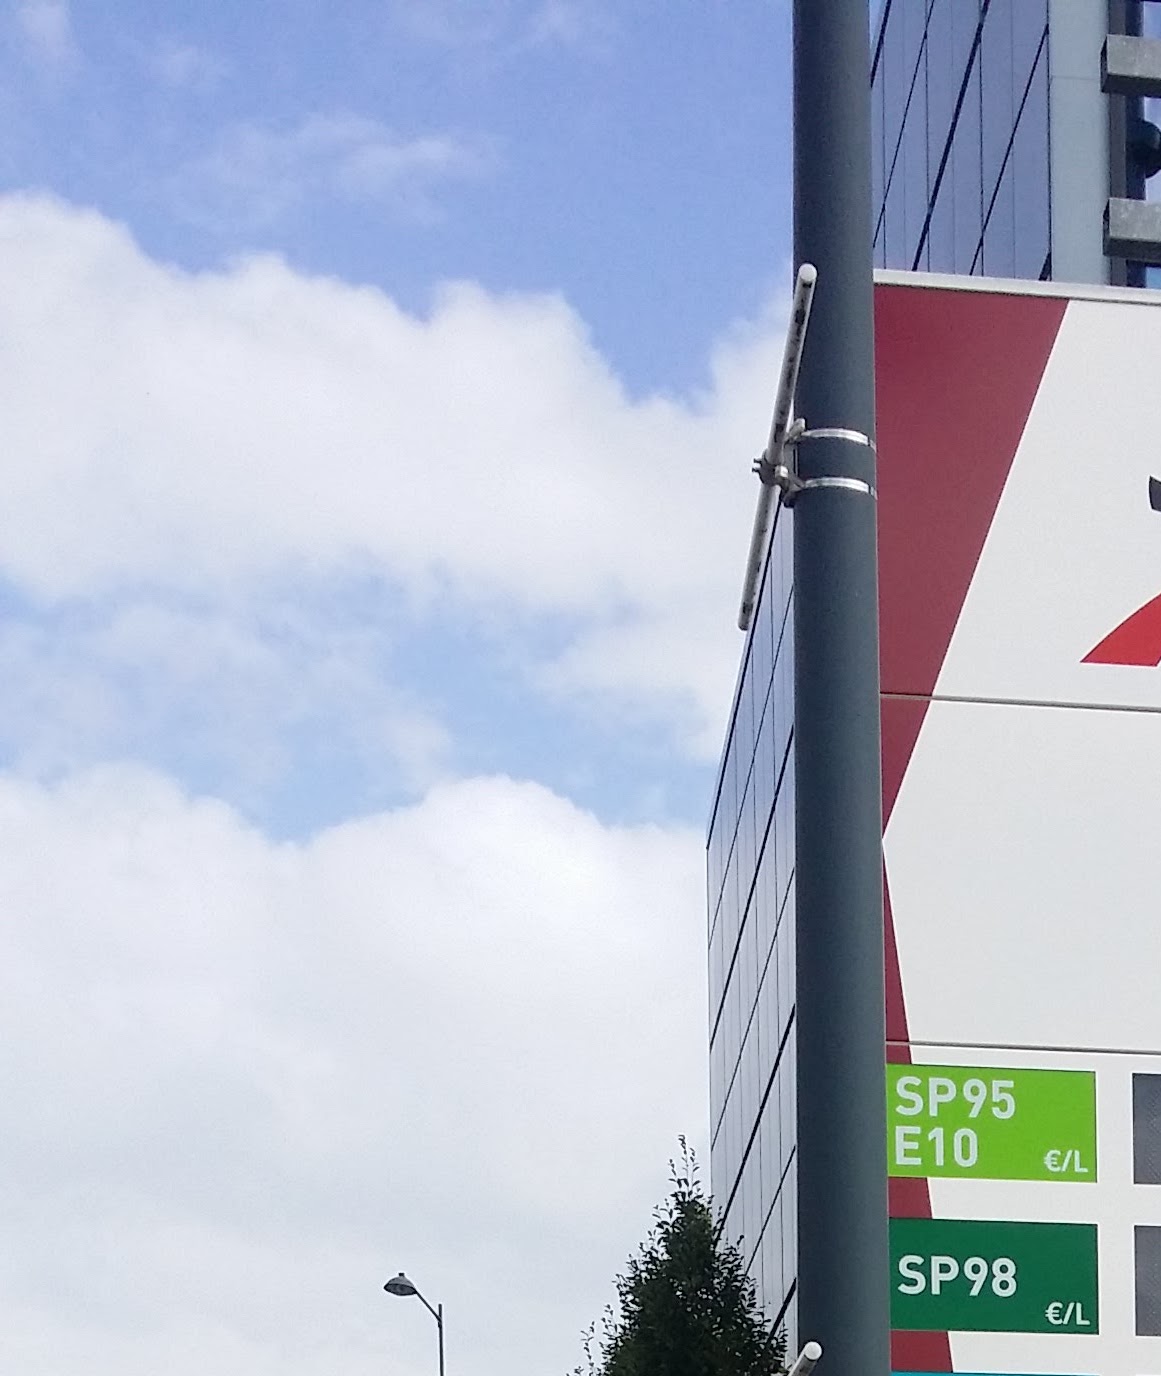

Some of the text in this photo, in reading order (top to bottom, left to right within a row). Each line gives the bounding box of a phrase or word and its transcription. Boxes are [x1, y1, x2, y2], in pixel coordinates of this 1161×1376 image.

[895, 1076, 1016, 1120] SP95
[895, 1126, 979, 1168] E10
[1043, 1149, 1089, 1174] €/L
[897, 1255, 1017, 1297] SP98
[1045, 1302, 1091, 1326] €/L
